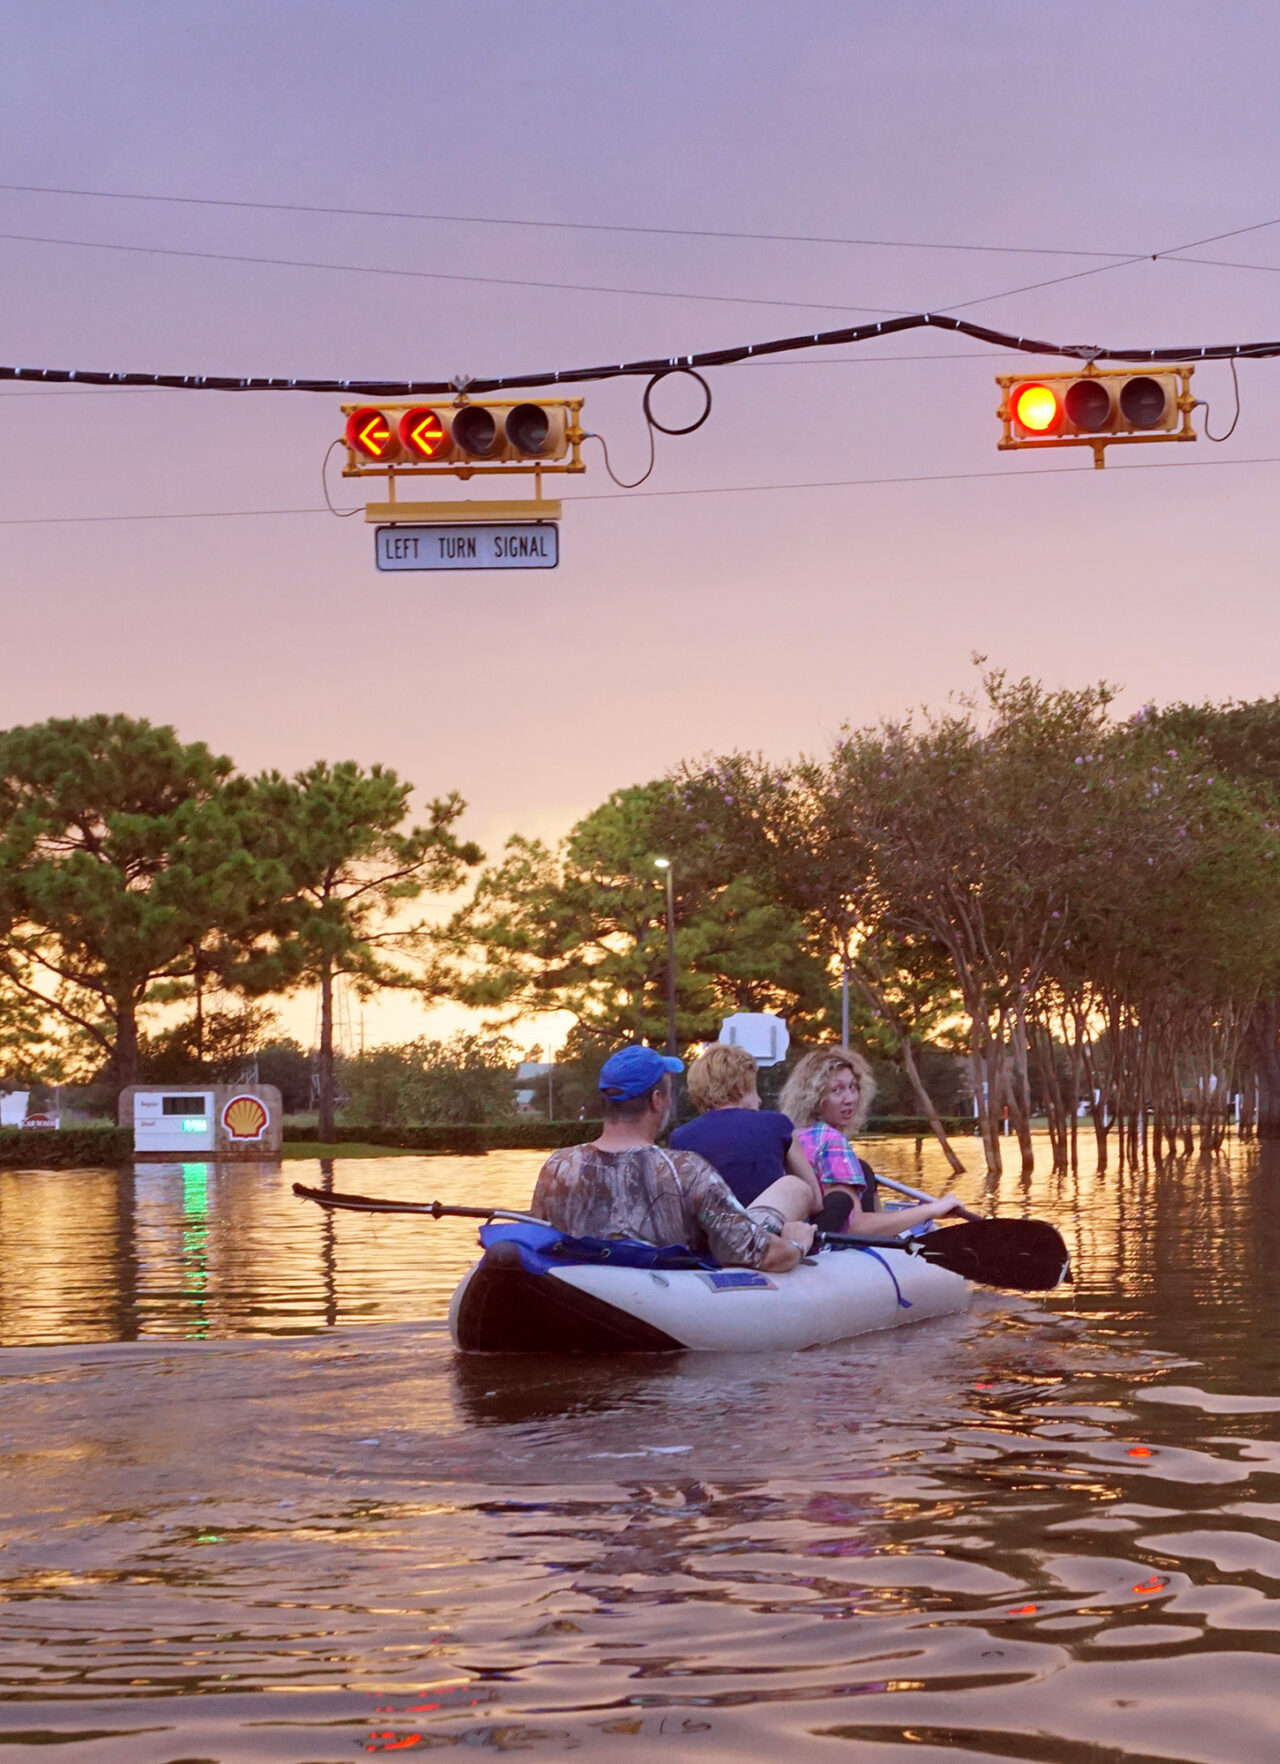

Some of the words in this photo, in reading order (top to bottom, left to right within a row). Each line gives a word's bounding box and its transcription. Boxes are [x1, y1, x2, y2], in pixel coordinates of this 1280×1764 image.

[385, 538, 420, 560] LEFT
[438, 537, 477, 559] TURN
[494, 536, 548, 558] SIGNAL
